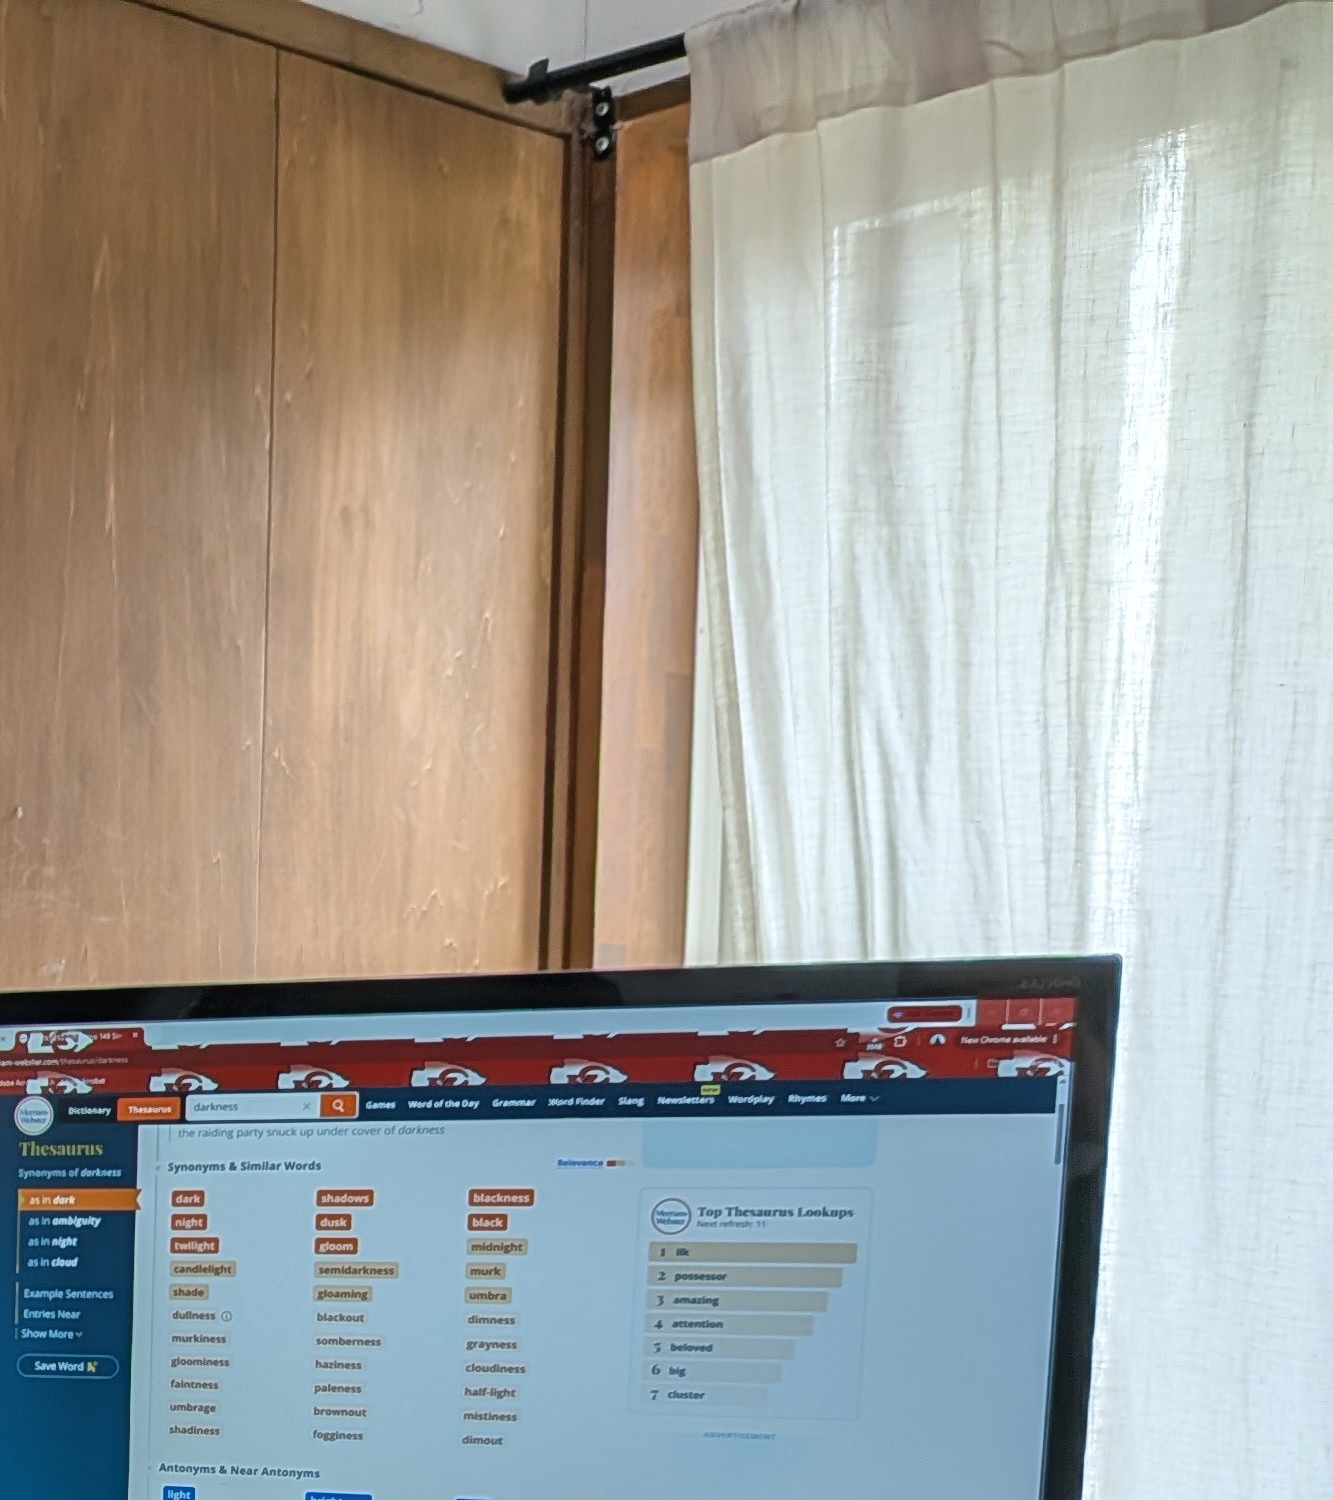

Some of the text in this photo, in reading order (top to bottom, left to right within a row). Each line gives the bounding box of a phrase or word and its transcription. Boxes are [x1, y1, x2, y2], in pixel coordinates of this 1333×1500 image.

[68, 1105, 172, 1117] Dictionary Thesaurus
[194, 1102, 239, 1112] darkness
[19, 1141, 104, 1156] Thesaurus
[168, 1161, 322, 1173] Synonyms & Similar Words
[175, 1194, 201, 1204] dark
[321, 1194, 369, 1204] shadows
[473, 1192, 530, 1204] blackness
[697, 1207, 854, 1220] Top Thesaurus Lookups
[175, 1217, 203, 1230] night
[472, 1217, 503, 1228] black
[174, 1241, 215, 1252] twilight
[471, 1241, 523, 1254] midnight
[173, 1264, 232, 1275] candlelight
[319, 1266, 395, 1275] semidarkness
[159, 1463, 320, 1479] Antonyms & Near Antonyms
[167, 1489, 191, 1500] light
